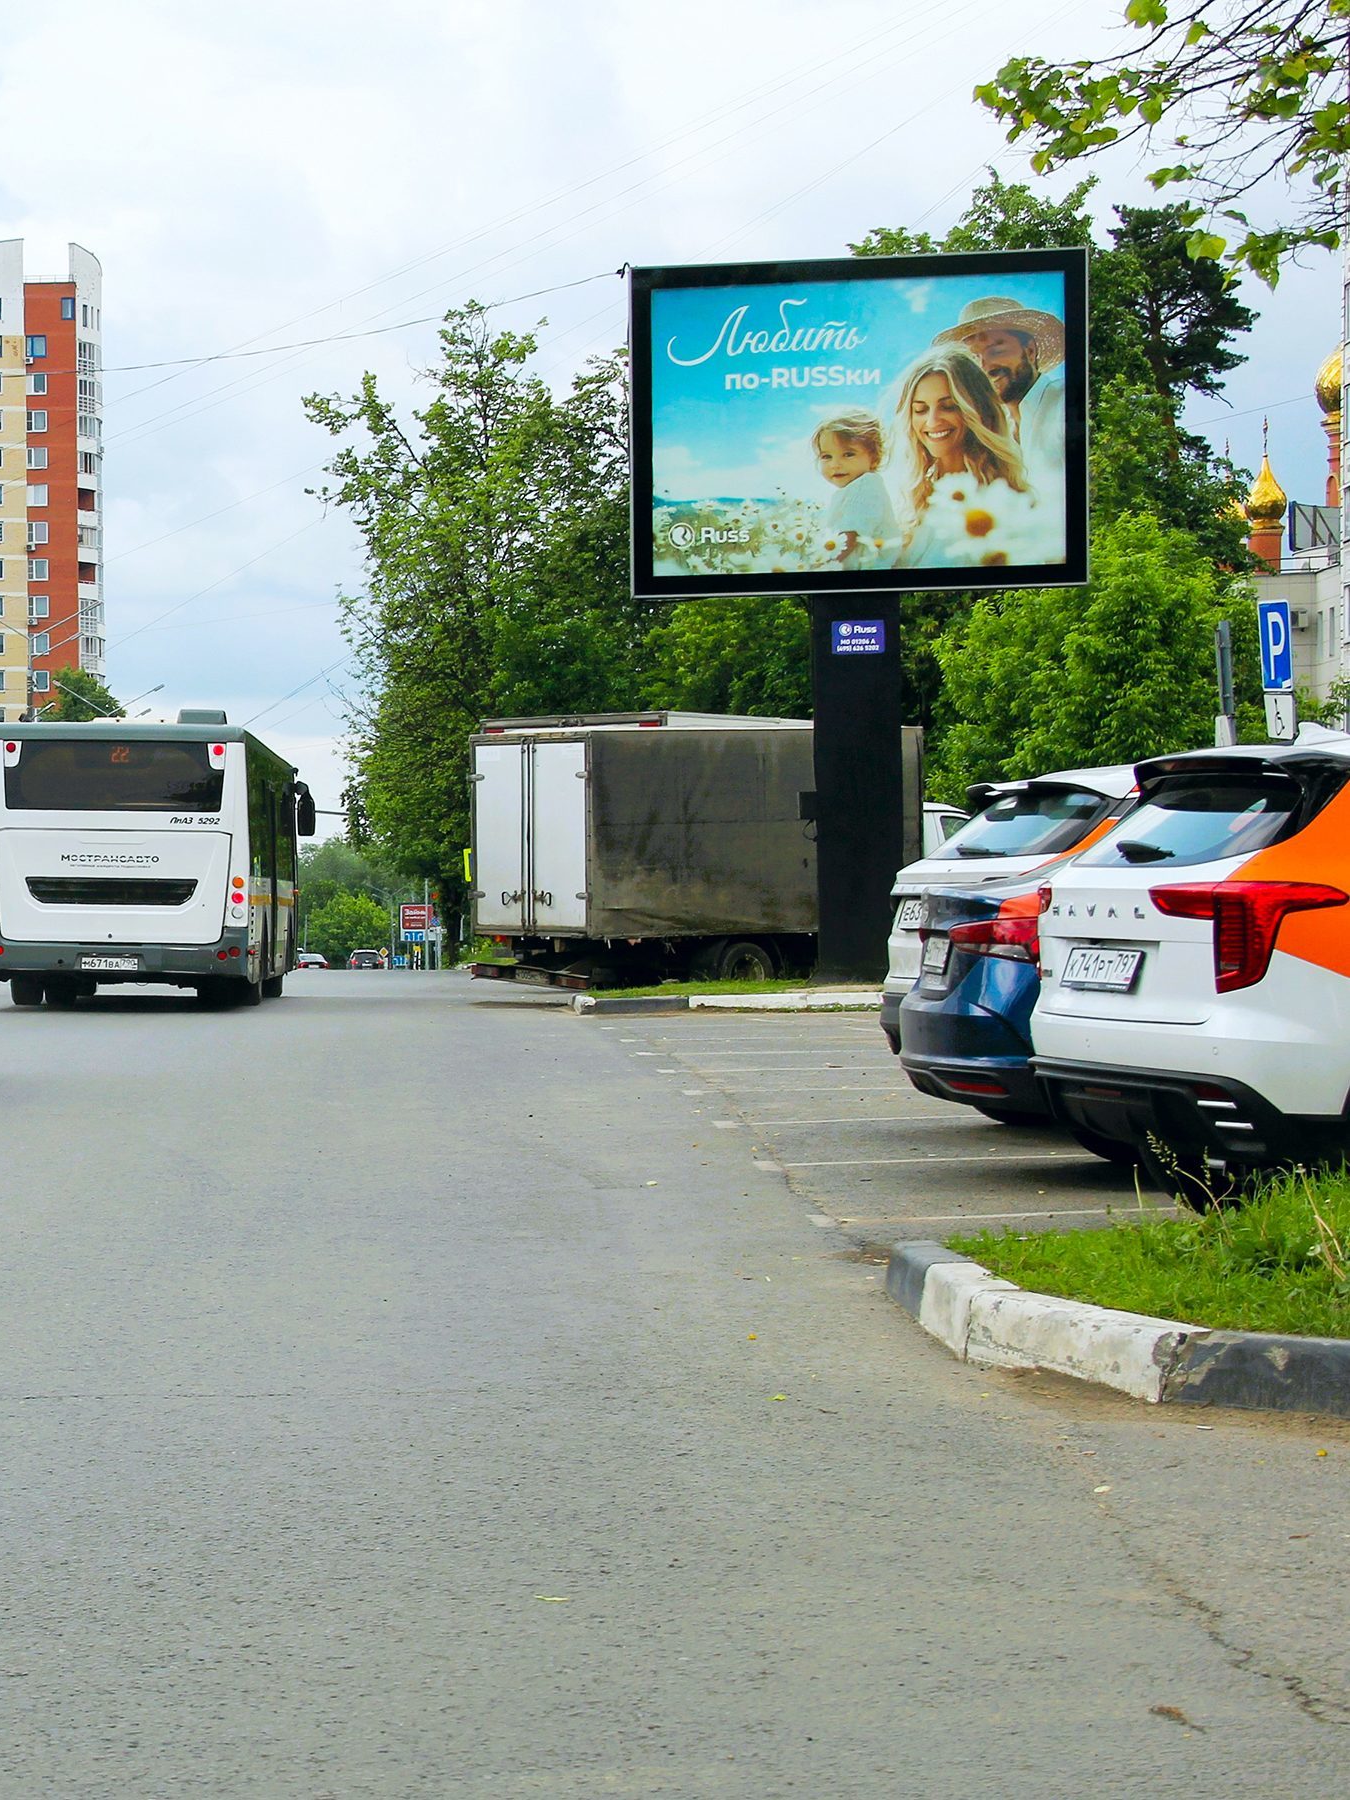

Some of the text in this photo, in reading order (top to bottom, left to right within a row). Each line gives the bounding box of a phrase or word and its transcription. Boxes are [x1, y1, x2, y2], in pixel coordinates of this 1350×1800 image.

[667, 298, 867, 366] Любить
[724, 365, 881, 390] по-RUSSки
[701, 527, 750, 544] Russ
[854, 626, 877, 634] Russ
[1267, 612, 1285, 680] P
[197, 816, 221, 825] 5292
[1052, 903, 1146, 919] HAVAL
